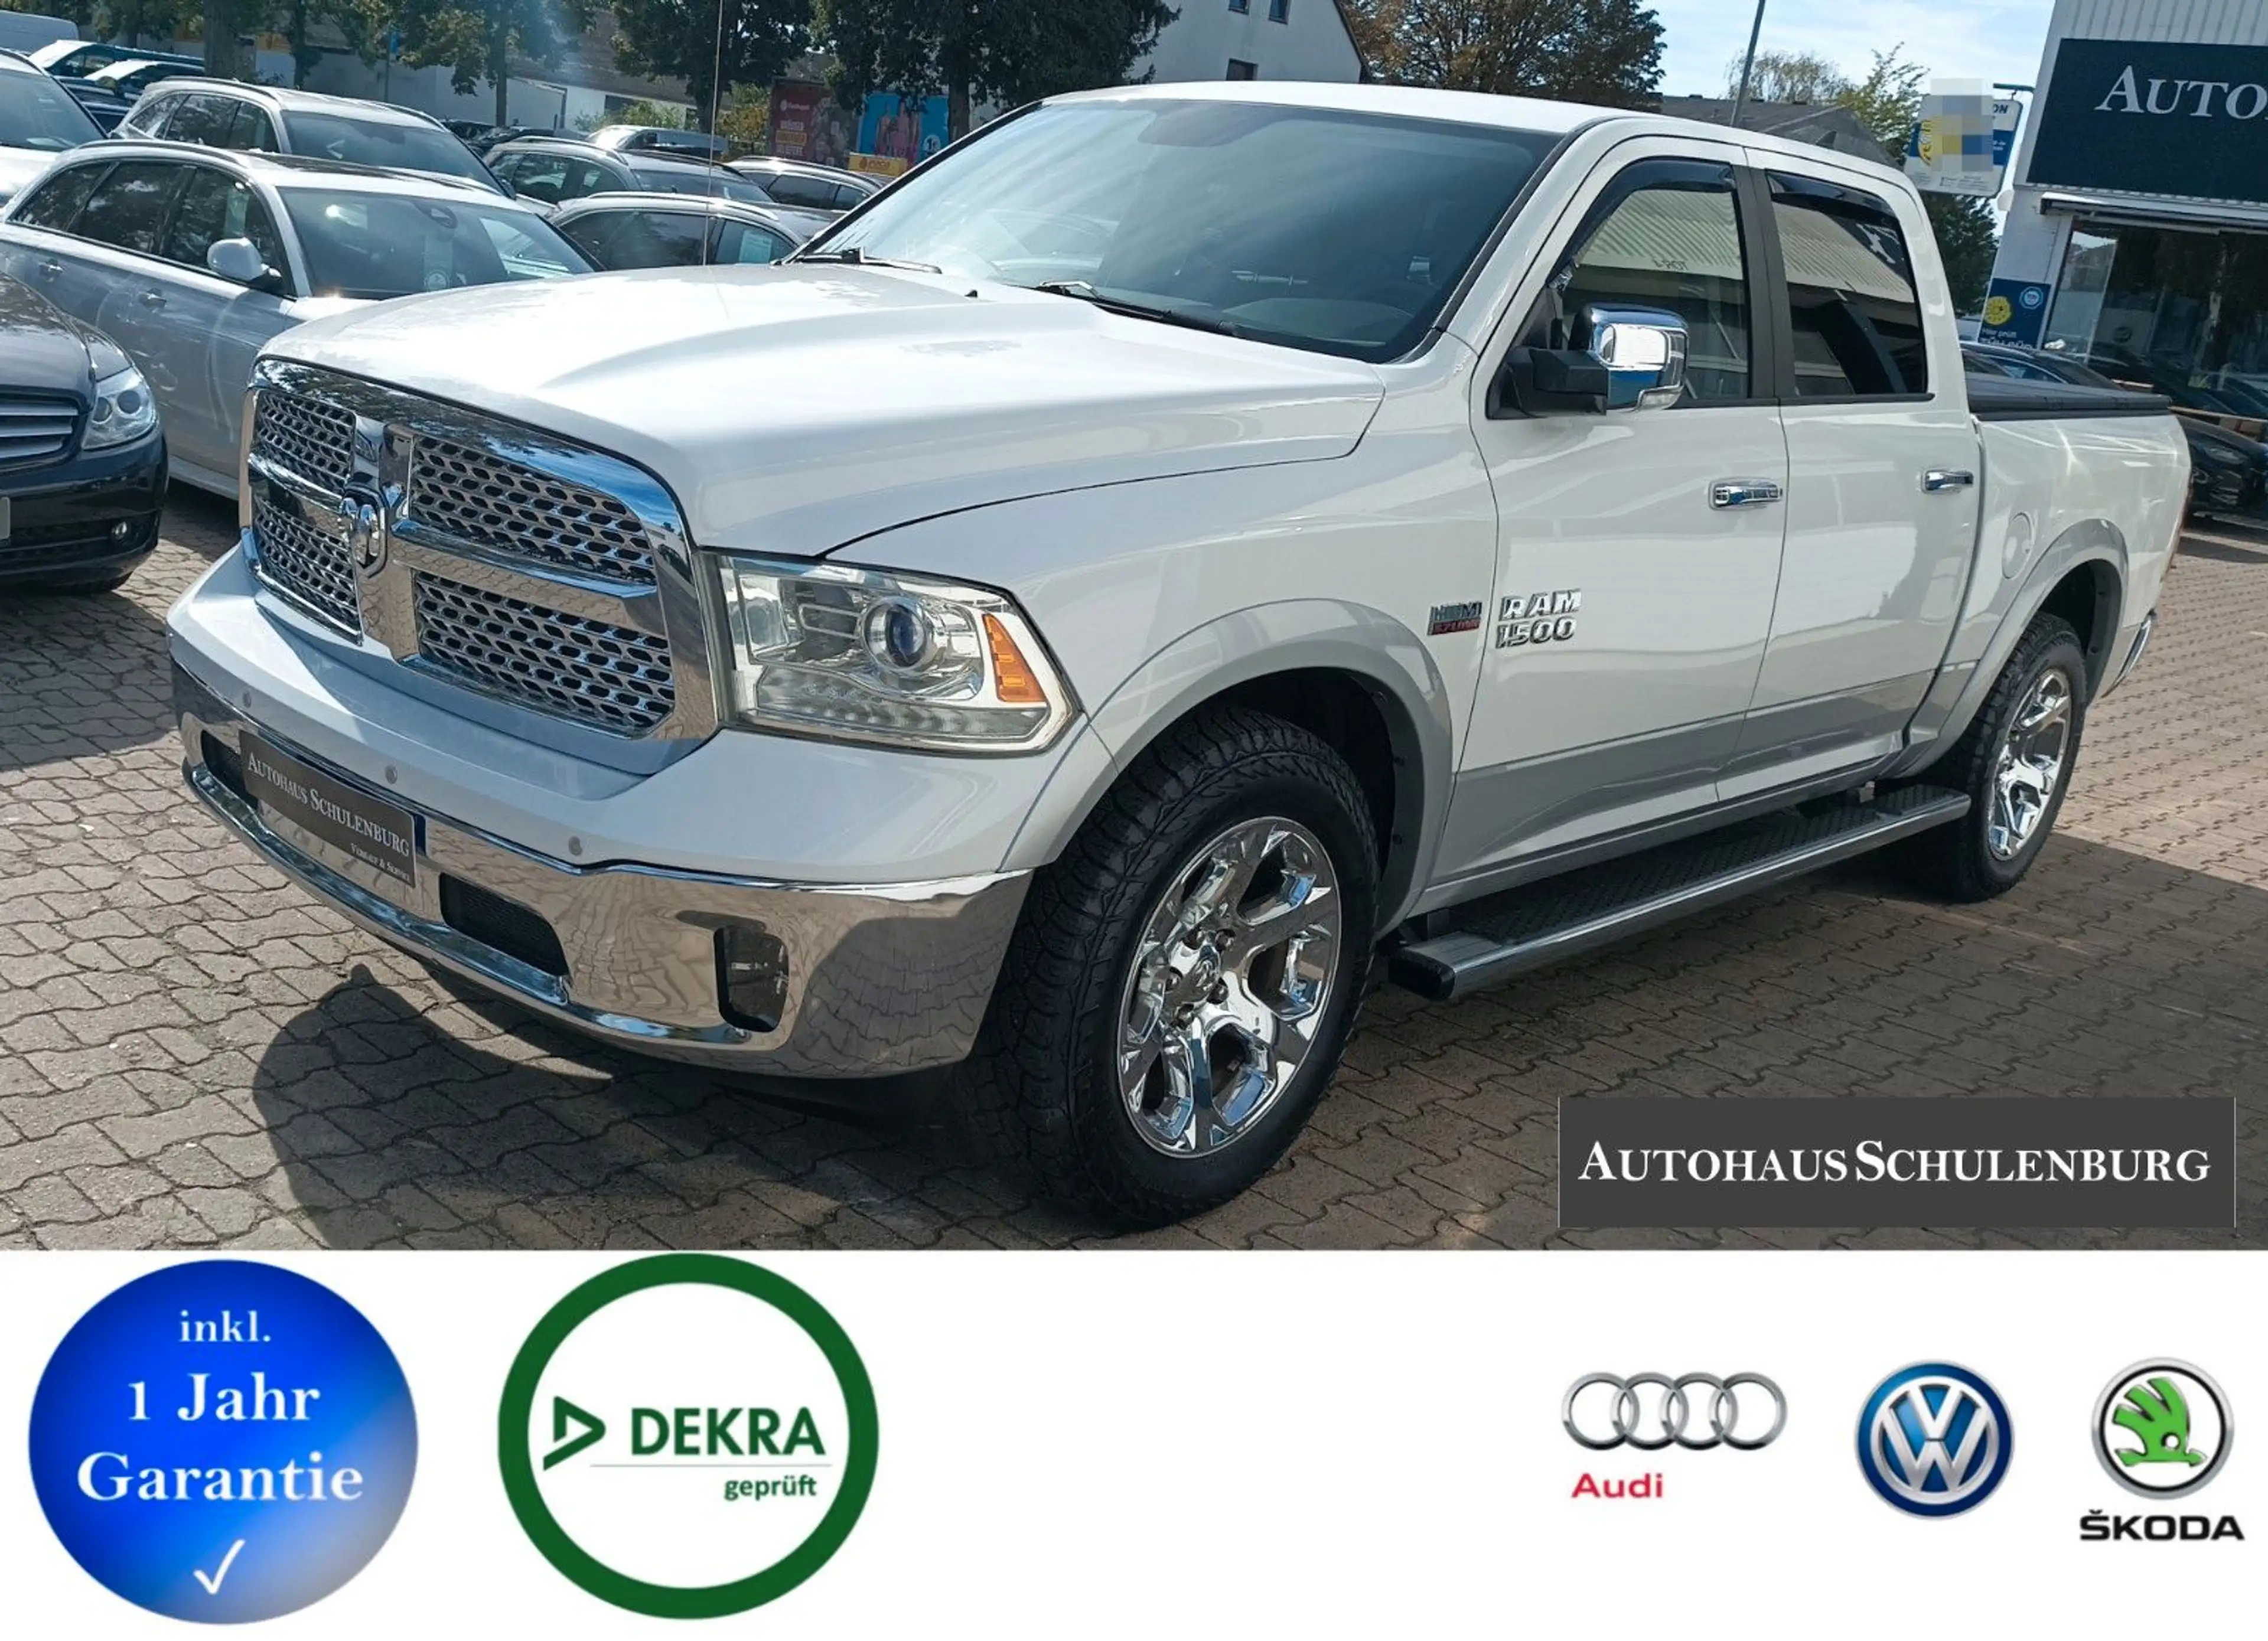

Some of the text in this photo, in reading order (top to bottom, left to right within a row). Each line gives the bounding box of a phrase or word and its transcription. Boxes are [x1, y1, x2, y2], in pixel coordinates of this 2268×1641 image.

[2094, 65, 2268, 120] AUTO
[1498, 589, 1582, 621] RAM
[1495, 616, 1576, 648] 1500
